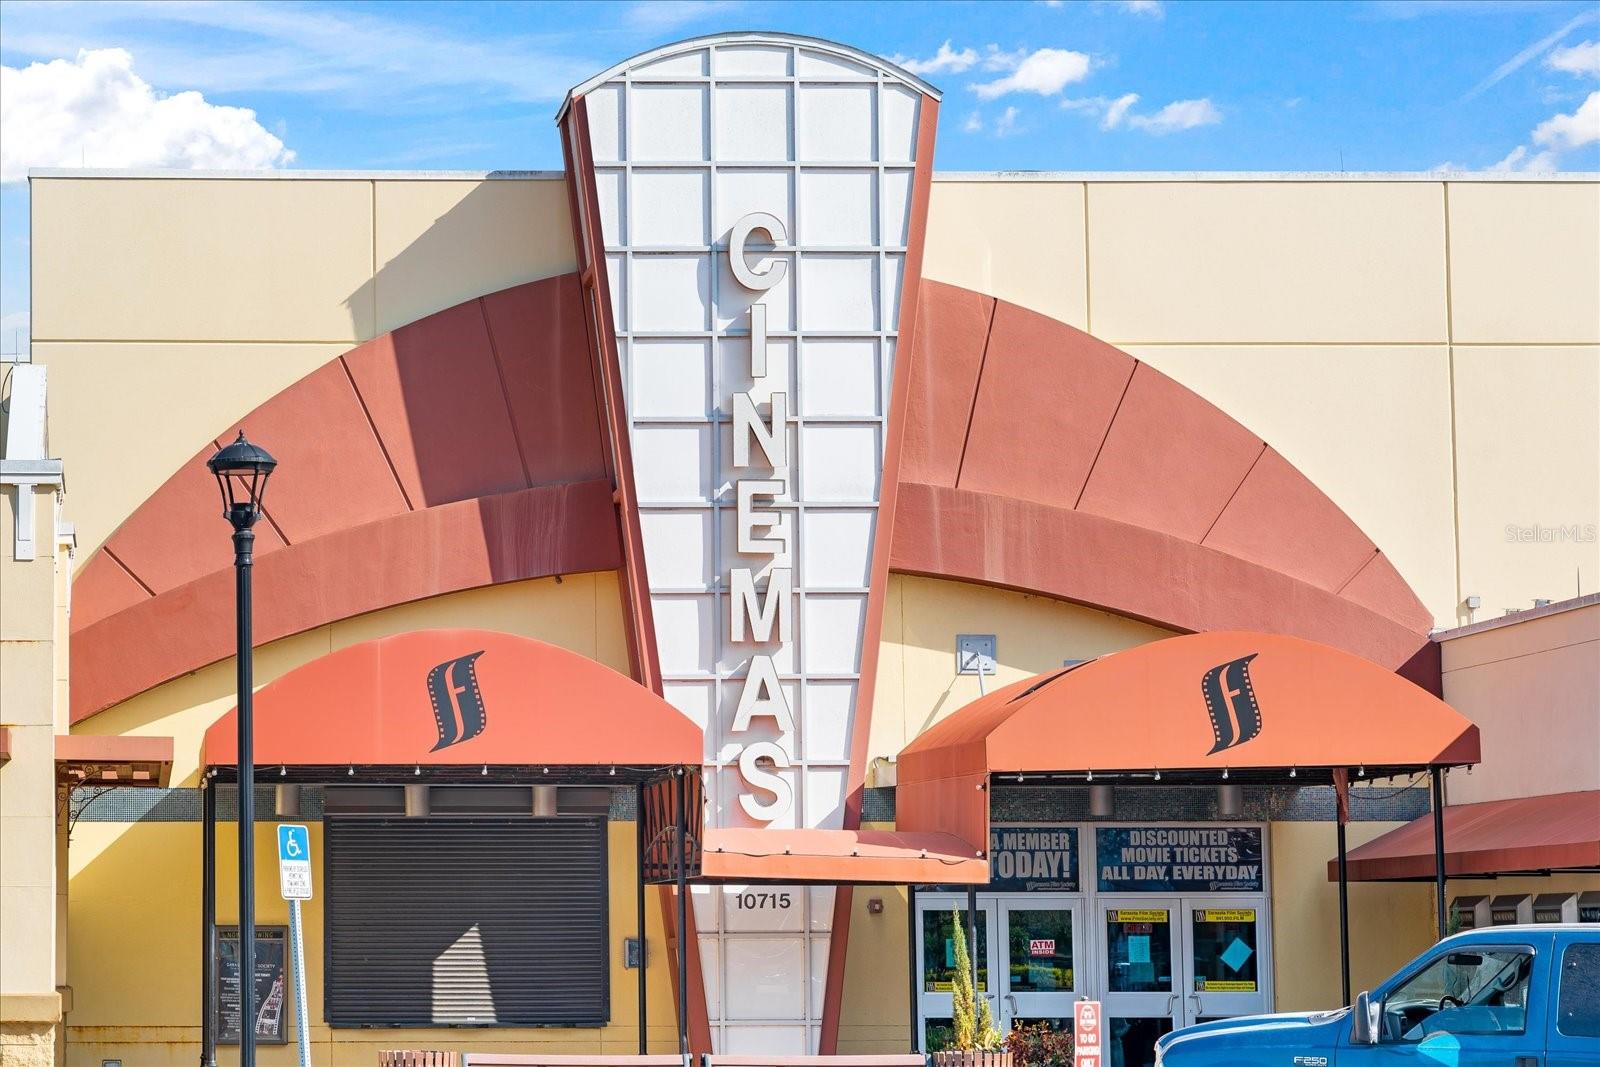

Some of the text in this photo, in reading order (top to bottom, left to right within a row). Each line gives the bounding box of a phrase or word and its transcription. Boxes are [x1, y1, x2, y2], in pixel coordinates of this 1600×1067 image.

[729, 212, 796, 821] CINEMAS
[990, 833, 1070, 850] A MEMBER
[1130, 830, 1228, 846] DISCOUNTED
[1121, 847, 1238, 863] MOVIE TICKETS
[1101, 865, 1259, 881] ALL DAY, EVERYDAY
[735, 893, 791, 909] 10715
[1031, 941, 1054, 949] ATM
[1079, 1033, 1097, 1044] TO GO
[1293, 1056, 1328, 1064] F250
